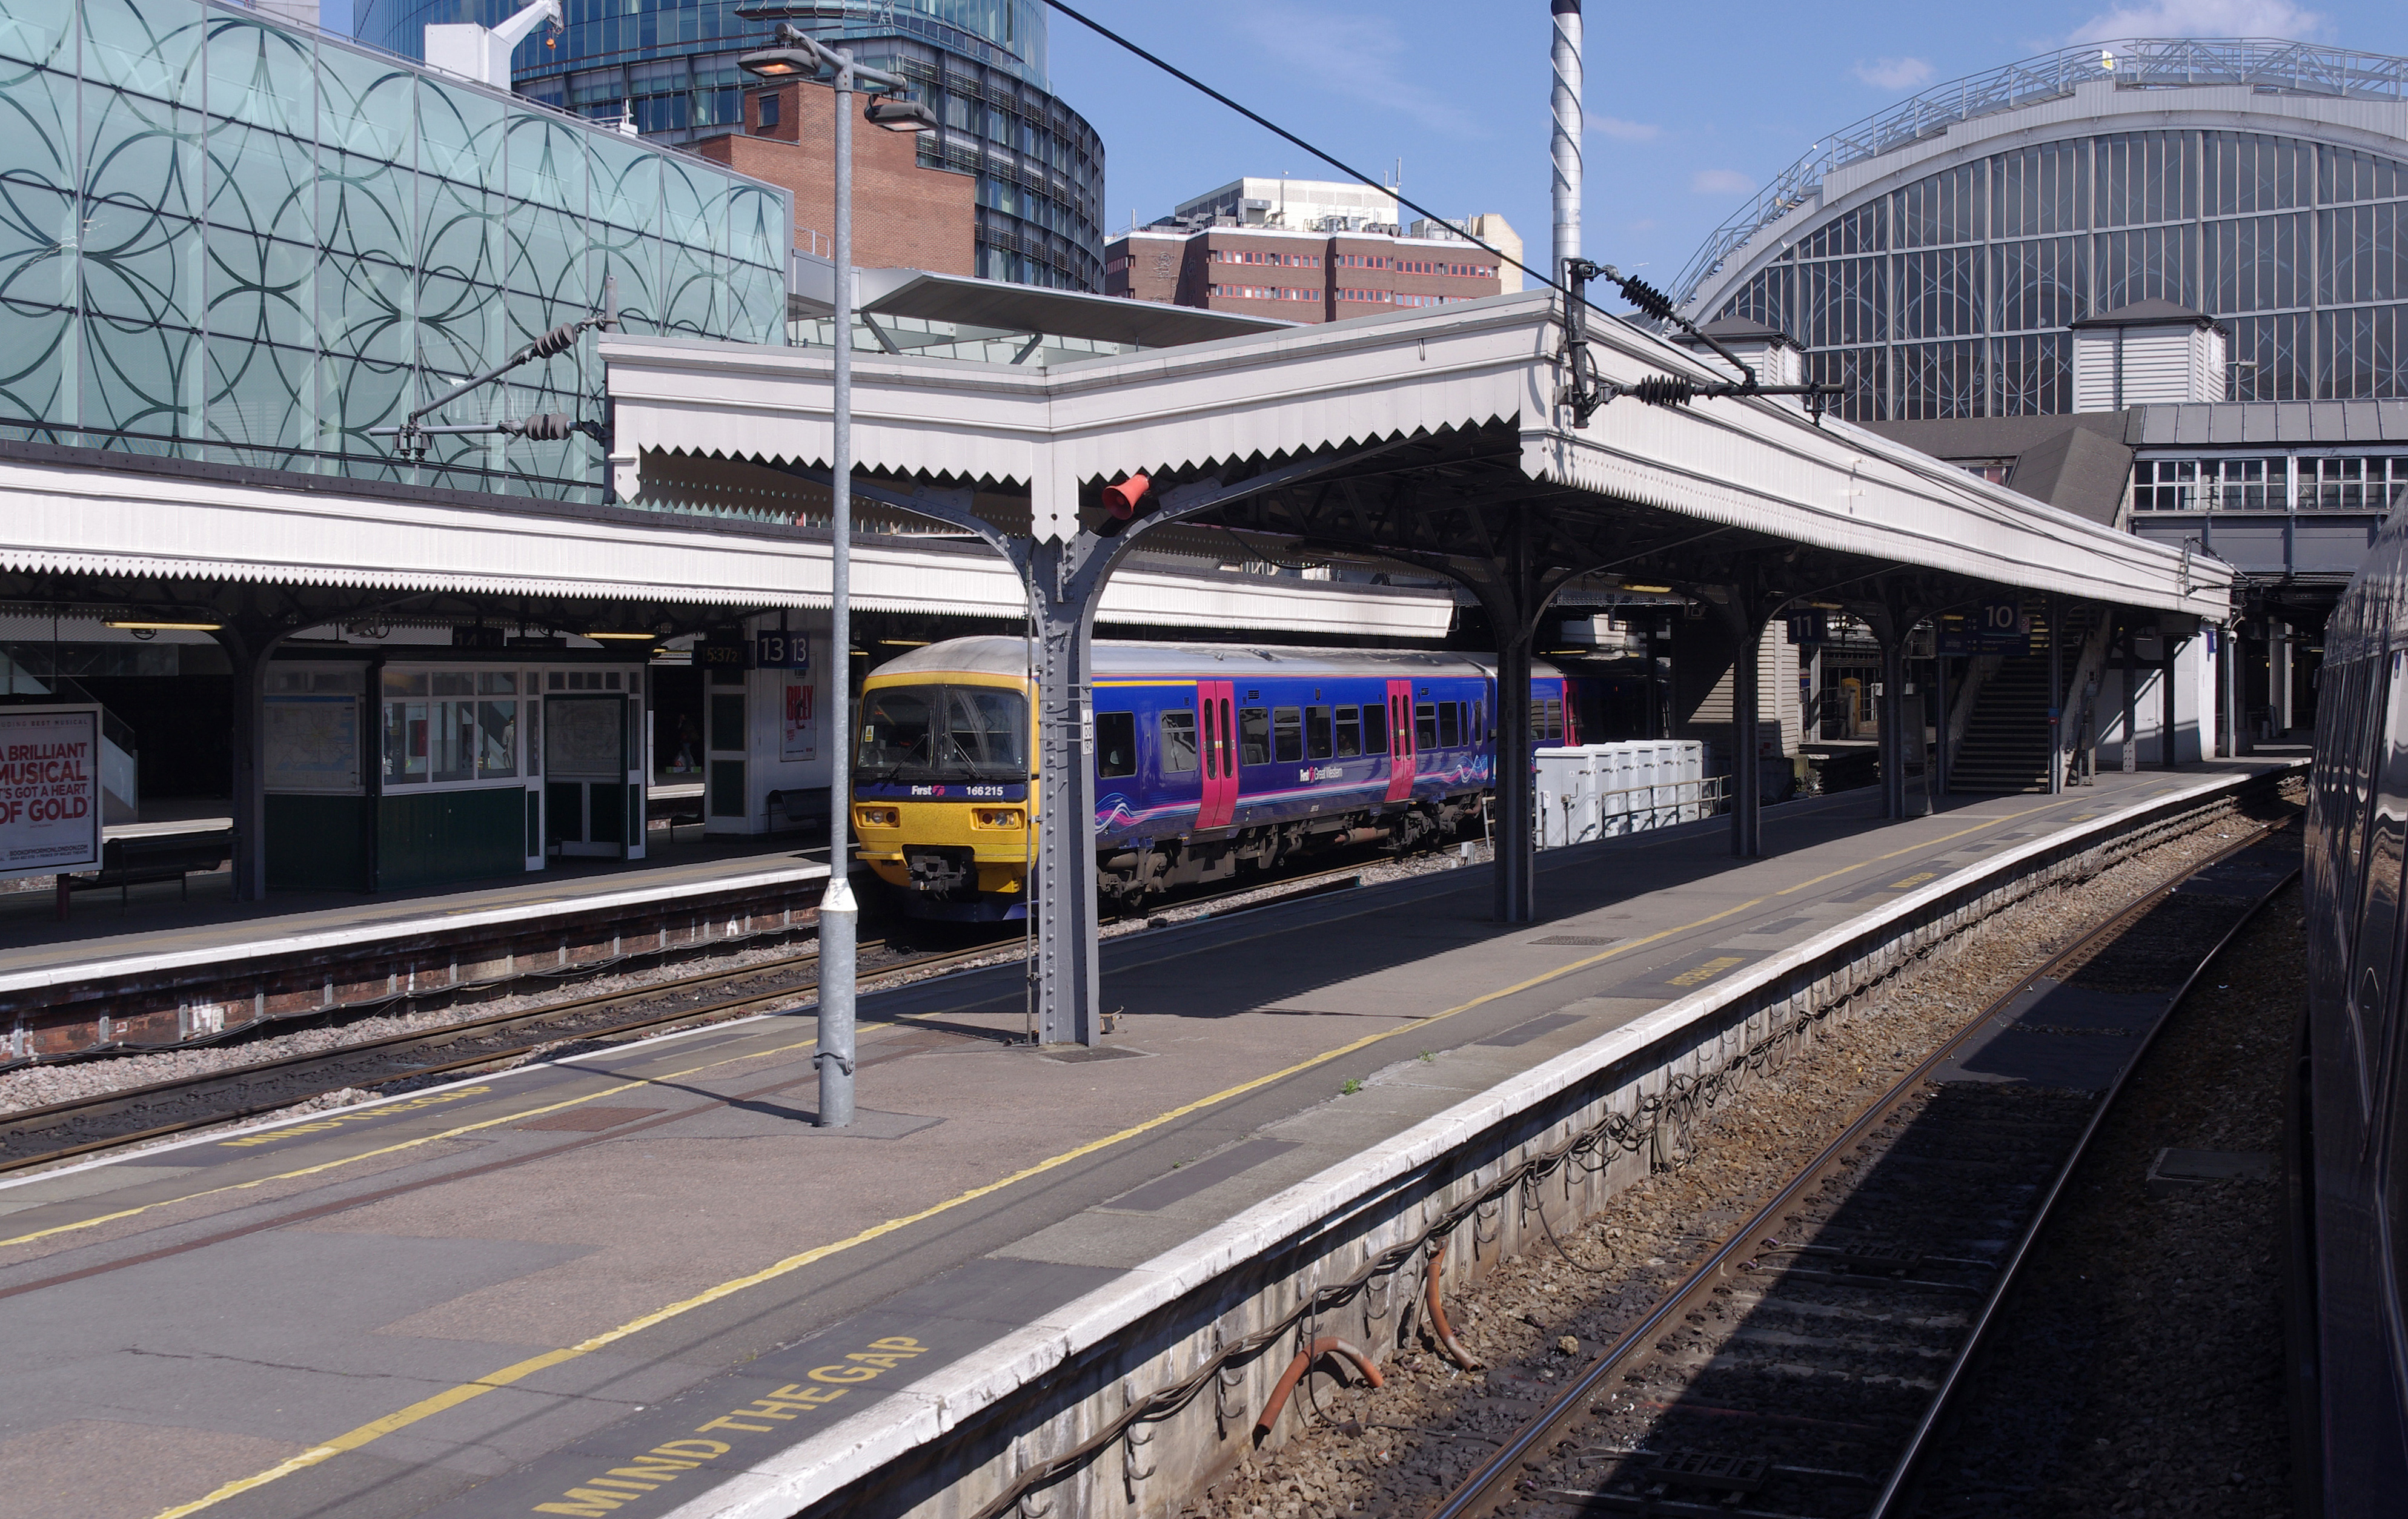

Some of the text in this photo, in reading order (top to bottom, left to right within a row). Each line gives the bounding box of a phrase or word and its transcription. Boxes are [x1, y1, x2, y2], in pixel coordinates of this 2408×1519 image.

[1793, 615, 1812, 637] 11
[1984, 605, 2013, 628] 10
[761, 638, 784, 661] 13
[792, 638, 807, 662] 13
[8, 742, 87, 761] BRILLIANT
[1314, 767, 1325, 781] Great
[1325, 766, 1343, 779] Western
[15, 786, 38, 799] GOT
[41, 786, 49, 797] A
[51, 783, 87, 796] HEART
[911, 784, 932, 796] First
[966, 786, 1004, 796] 166215
[217, 1086, 492, 1147] MIND THE GAP
[531, 1335, 929, 1518] MIND THE GAP
